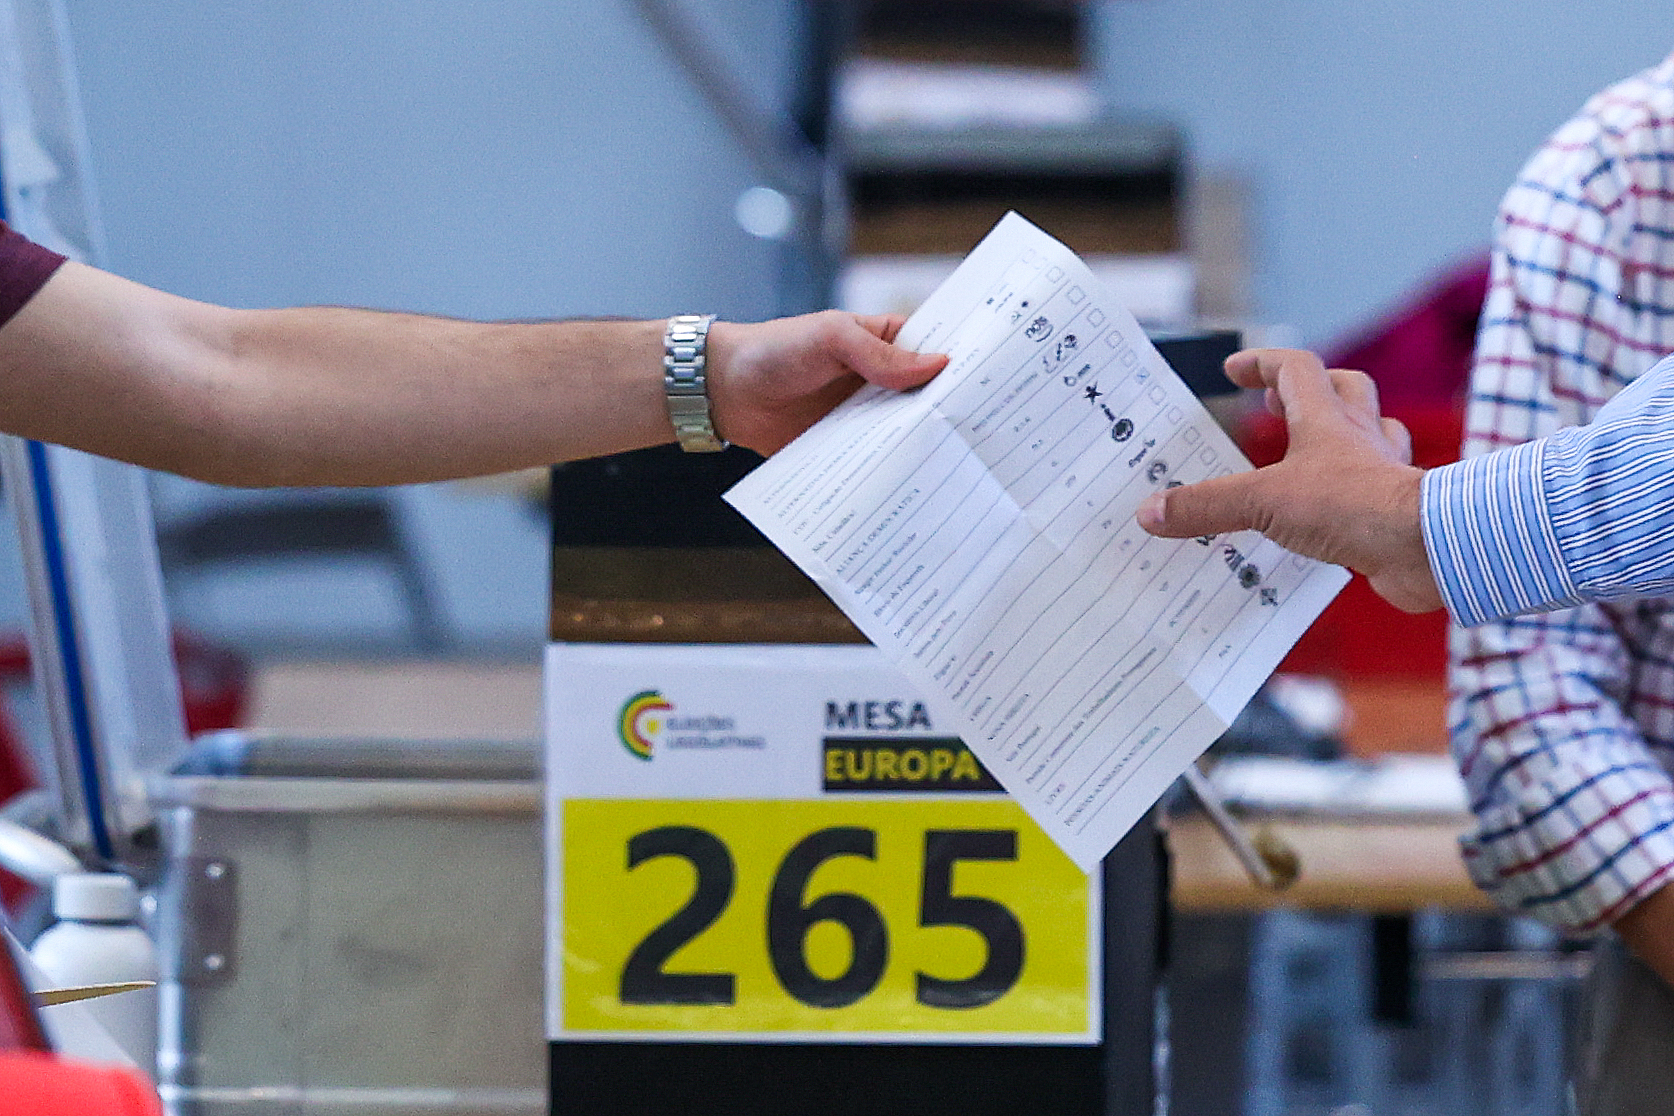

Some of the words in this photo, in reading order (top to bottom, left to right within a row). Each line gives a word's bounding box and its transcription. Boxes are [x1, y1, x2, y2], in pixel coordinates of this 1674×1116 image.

[825, 700, 932, 730] MESA
[825, 748, 981, 781] EUROPA
[618, 824, 1027, 1010] 265
